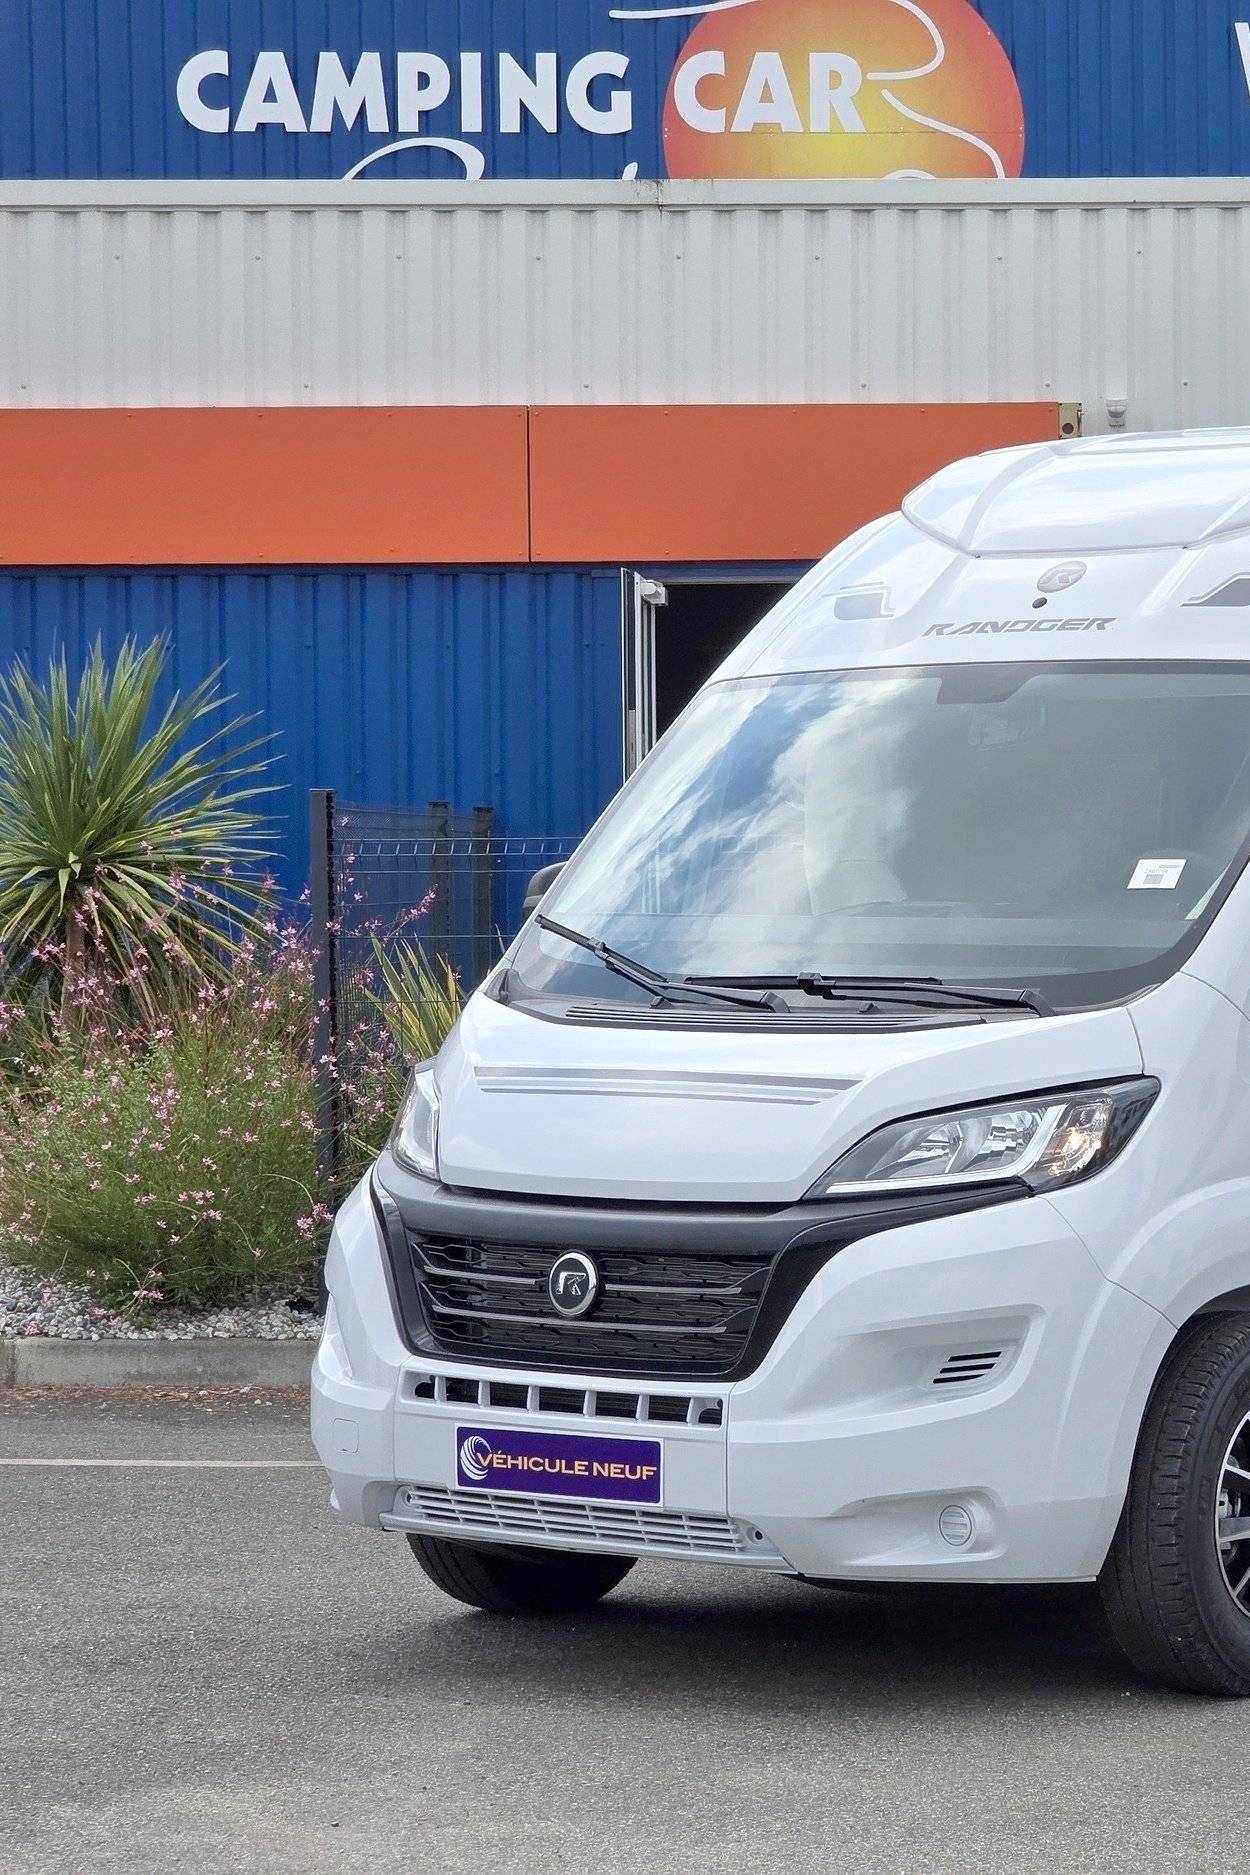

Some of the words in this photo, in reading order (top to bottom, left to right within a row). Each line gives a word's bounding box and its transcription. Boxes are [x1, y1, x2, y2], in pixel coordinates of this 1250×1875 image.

[175, 49, 633, 135] CAMPING
[673, 50, 864, 134] CAR
[477, 1450, 589, 1476] VÉHICULE
[593, 1463, 657, 1480] NEUF
